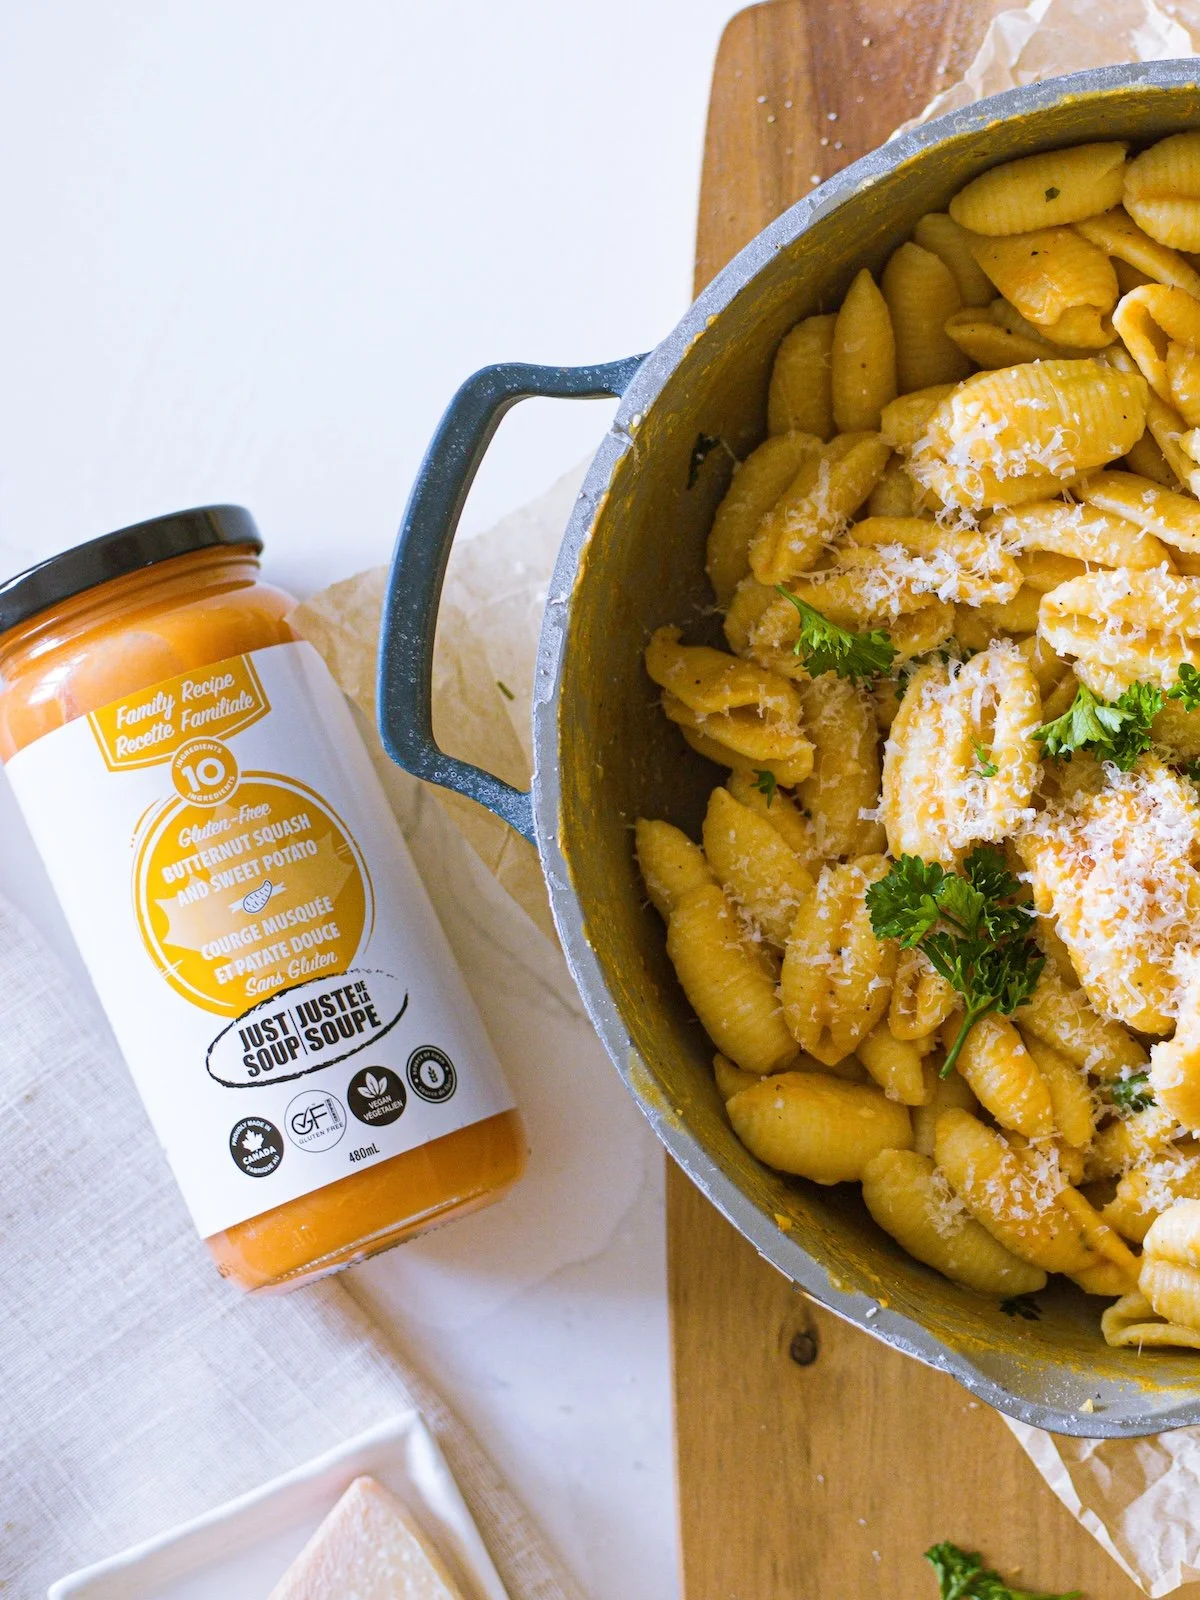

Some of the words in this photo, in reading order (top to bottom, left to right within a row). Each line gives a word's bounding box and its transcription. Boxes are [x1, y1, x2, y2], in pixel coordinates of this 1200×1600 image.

[116, 691, 175, 729] Family
[181, 673, 235, 702] Recipe
[115, 722, 175, 759] Recette
[180, 690, 255, 732] Familiale
[181, 757, 226, 792] 10
[178, 803, 272, 848] Gluten-Free
[161, 834, 250, 884] BUTTERNUT
[253, 813, 312, 847] SQUASH
[176, 879, 209, 907] AND
[210, 859, 262, 893] SWEET
[262, 839, 318, 871] POTATO
[201, 924, 262, 961] COURGE
[261, 895, 334, 936] MUSQUÉE
[214, 963, 234, 985] ET
[235, 941, 291, 976] PATATE
[290, 922, 341, 953] DOUCE
[244, 971, 285, 997] Sans
[287, 951, 338, 979] Gluten
[295, 984, 360, 1029] JUSTE
[355, 980, 367, 993] DE
[359, 991, 371, 1003] LA
[238, 1012, 290, 1053] JUST
[304, 1004, 382, 1051] SOUPE
[242, 1035, 300, 1077] SOUP
[368, 1094, 392, 1110] VEGAN
[232, 1121, 248, 1146] PROUDLY
[247, 1119, 265, 1128] MADE
[264, 1123, 272, 1132] IN
[299, 1130, 325, 1144] GLUTEN
[326, 1122, 344, 1133] FREE
[349, 1142, 380, 1163] 480mL
[242, 1145, 277, 1165] CANADA
